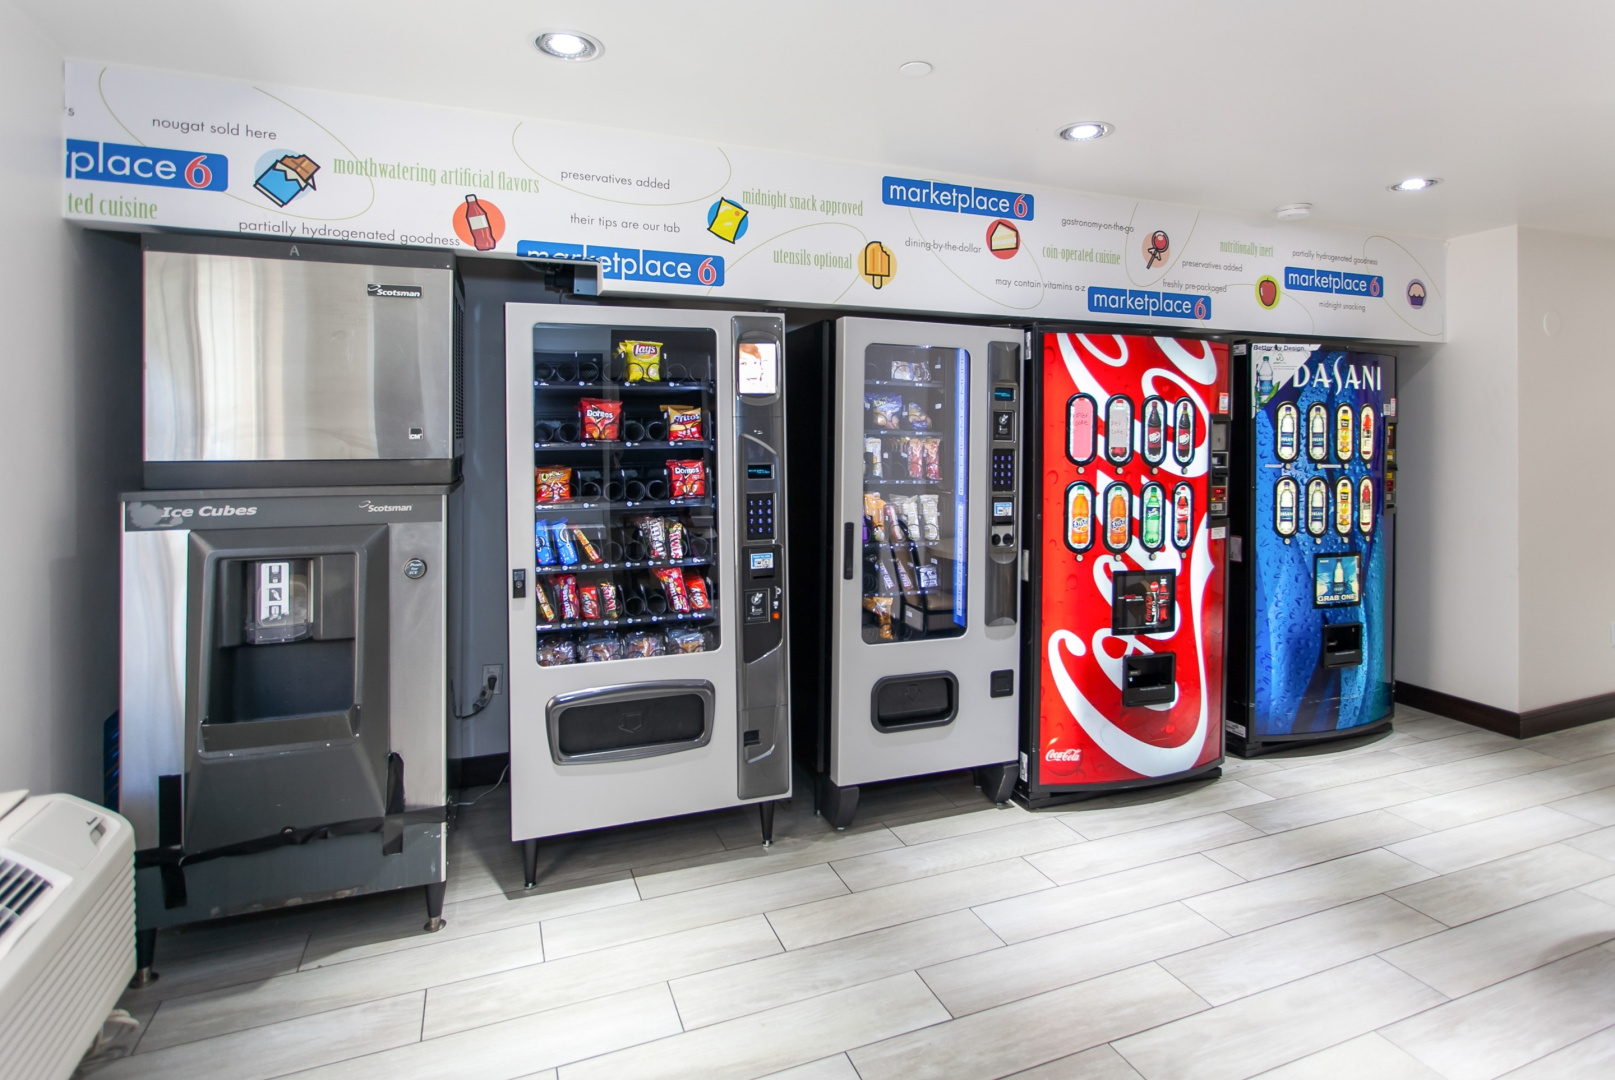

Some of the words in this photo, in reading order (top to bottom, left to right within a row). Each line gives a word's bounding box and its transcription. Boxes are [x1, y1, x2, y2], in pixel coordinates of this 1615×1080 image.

[152, 116, 205, 134] nougat
[210, 122, 240, 136] sold
[245, 125, 277, 141] here
[66, 141, 177, 180] place
[184, 155, 213, 188] 6
[333, 156, 436, 186] mouthwatering
[440, 168, 495, 190] artificial
[498, 172, 540, 193] flavors
[560, 169, 632, 186] preservatives
[636, 176, 670, 190] added
[67, 193, 94, 216] ted
[100, 195, 158, 220] cuisine
[742, 188, 787, 210] midnight
[789, 196, 817, 212] snack
[820, 198, 864, 218] approved
[890, 181, 1010, 214] marketplace
[1014, 193, 1028, 218] 6
[239, 218, 297, 237] partially
[302, 222, 396, 242] hydrogenated
[400, 231, 461, 248] goodness
[570, 214, 595, 228] their
[598, 216, 618, 230] tips
[621, 221, 640, 230] are
[643, 222, 660, 232] our
[664, 220, 681, 233] tab
[1060, 217, 1134, 234] gastronomy-on-the-go
[290, 245, 300, 257] A
[904, 238, 982, 254] dining-by-the-dollar
[1042, 244, 1094, 264] coin-operated
[1095, 247, 1121, 265] cuisine
[1220, 240, 1258, 258] nutritionally
[1259, 244, 1274, 258] inert
[773, 248, 812, 267] utensils
[814, 249, 852, 270] optional
[1182, 260, 1220, 272] preservatives
[1222, 262, 1243, 272] added
[1292, 248, 1314, 260] partially
[1316, 252, 1352, 264] hydrogenated
[1353, 256, 1378, 266] goodness
[697, 257, 718, 286] 6
[996, 276, 1012, 288] may
[1014, 278, 1042, 288] contain
[1043, 280, 1073, 292] vitamins
[1074, 284, 1086, 292] a-z
[1162, 278, 1184, 292] freshly
[1184, 282, 1228, 294] pre-packaged
[1288, 269, 1368, 294] marketplace
[1369, 277, 1380, 296] 6
[376, 288, 420, 298] Scotsman
[1093, 290, 1192, 316] marketplace
[1194, 297, 1206, 320] 6
[1318, 300, 1340, 311] midnight
[1342, 303, 1366, 314] snacking
[1293, 356, 1381, 395] DASANI
[161, 506, 194, 518] Ice
[198, 504, 258, 518] Cubes
[368, 504, 412, 513] Scotsman
[1045, 749, 1082, 762] Coca-Cola
